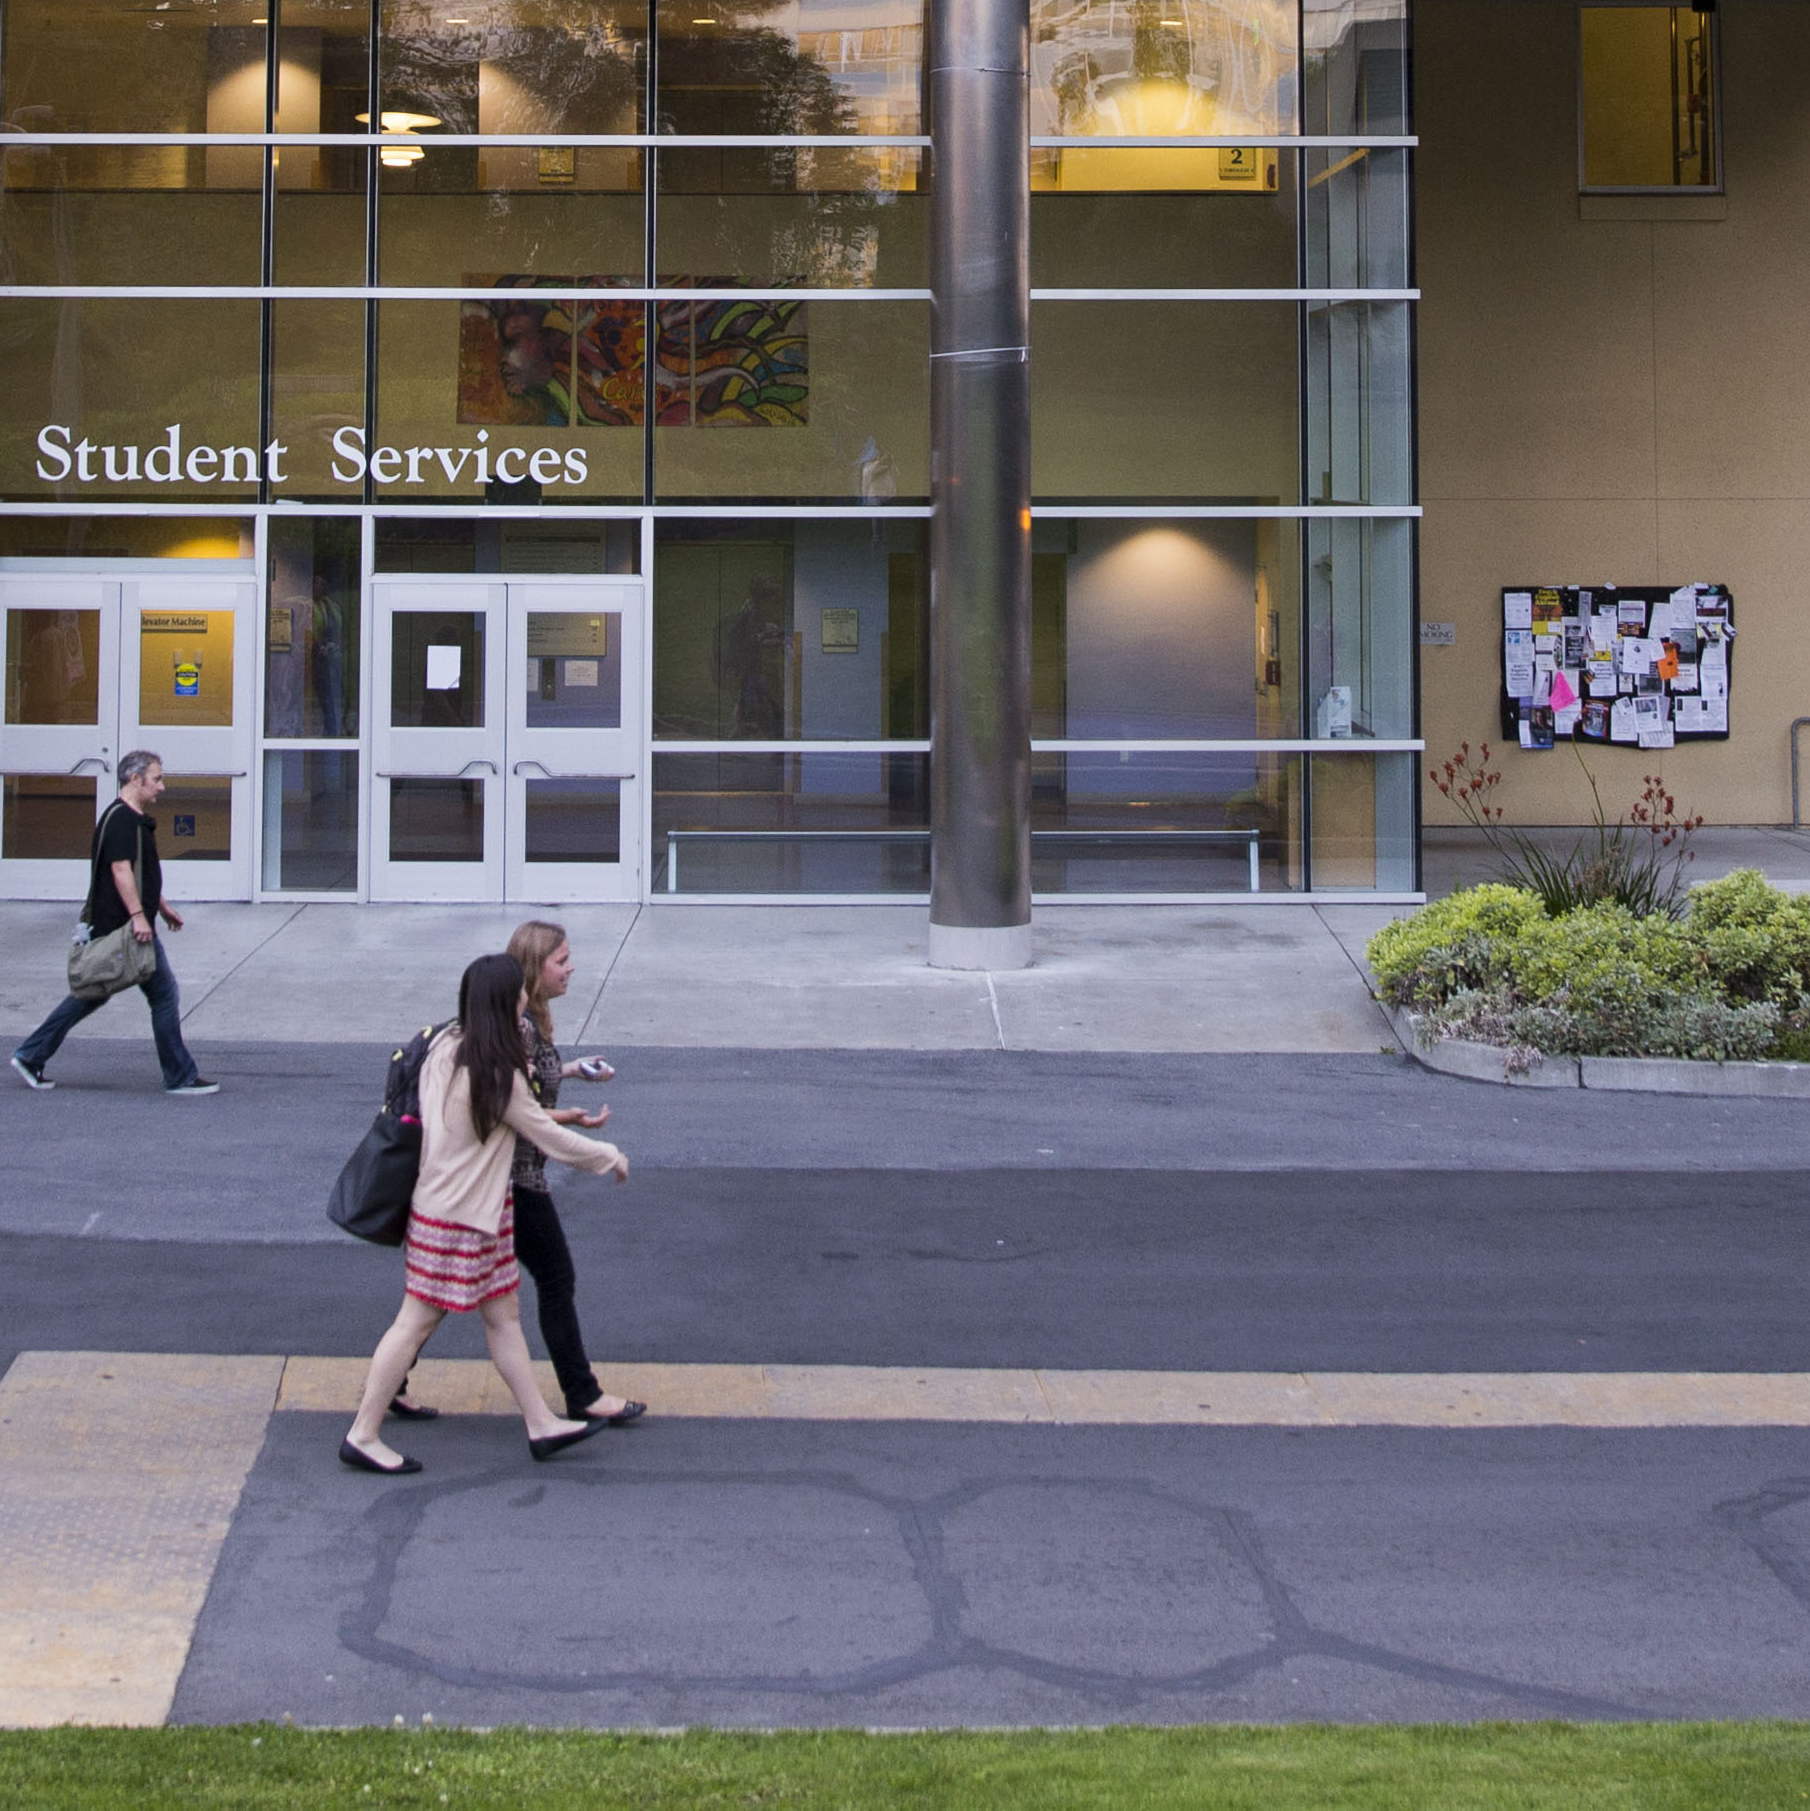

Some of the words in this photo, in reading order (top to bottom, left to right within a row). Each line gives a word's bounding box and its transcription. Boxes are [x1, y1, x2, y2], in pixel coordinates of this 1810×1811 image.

[1231, 148, 1243, 164] 2
[36, 423, 288, 483] Student
[331, 427, 589, 485] Services
[141, 616, 169, 626] levator
[172, 616, 206, 626] Machine
[1427, 623, 1441, 631] NO
[1420, 629, 1454, 638] MOKING
